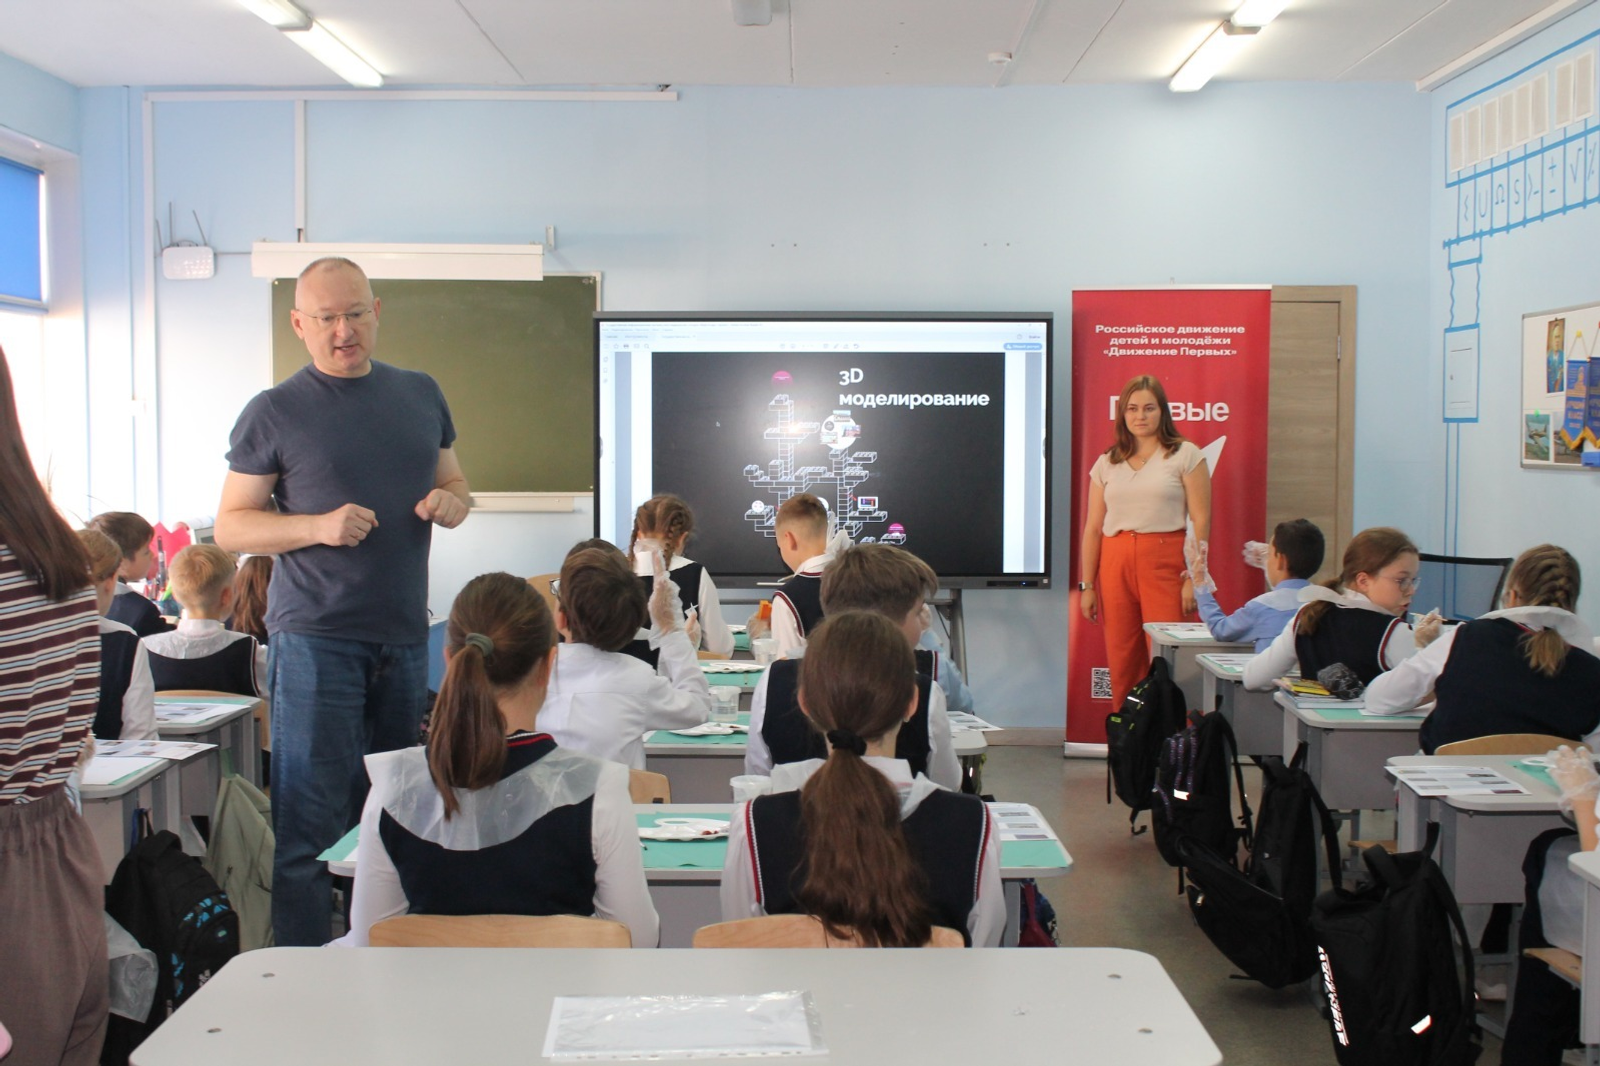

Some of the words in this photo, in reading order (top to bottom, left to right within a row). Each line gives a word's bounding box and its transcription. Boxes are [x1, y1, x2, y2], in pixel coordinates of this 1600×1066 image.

[1095, 325, 1175, 333] Российское
[1177, 326, 1245, 334] движение
[1109, 336, 1148, 345] детей
[1151, 337, 1160, 345] и
[1162, 336, 1231, 345] молодёжи
[1103, 347, 1178, 357] «Движение
[1180, 347, 1237, 357] Первых»
[839, 367, 864, 386] 3D
[839, 393, 990, 410] моделирование
[1109, 395, 1230, 421] Пвые
